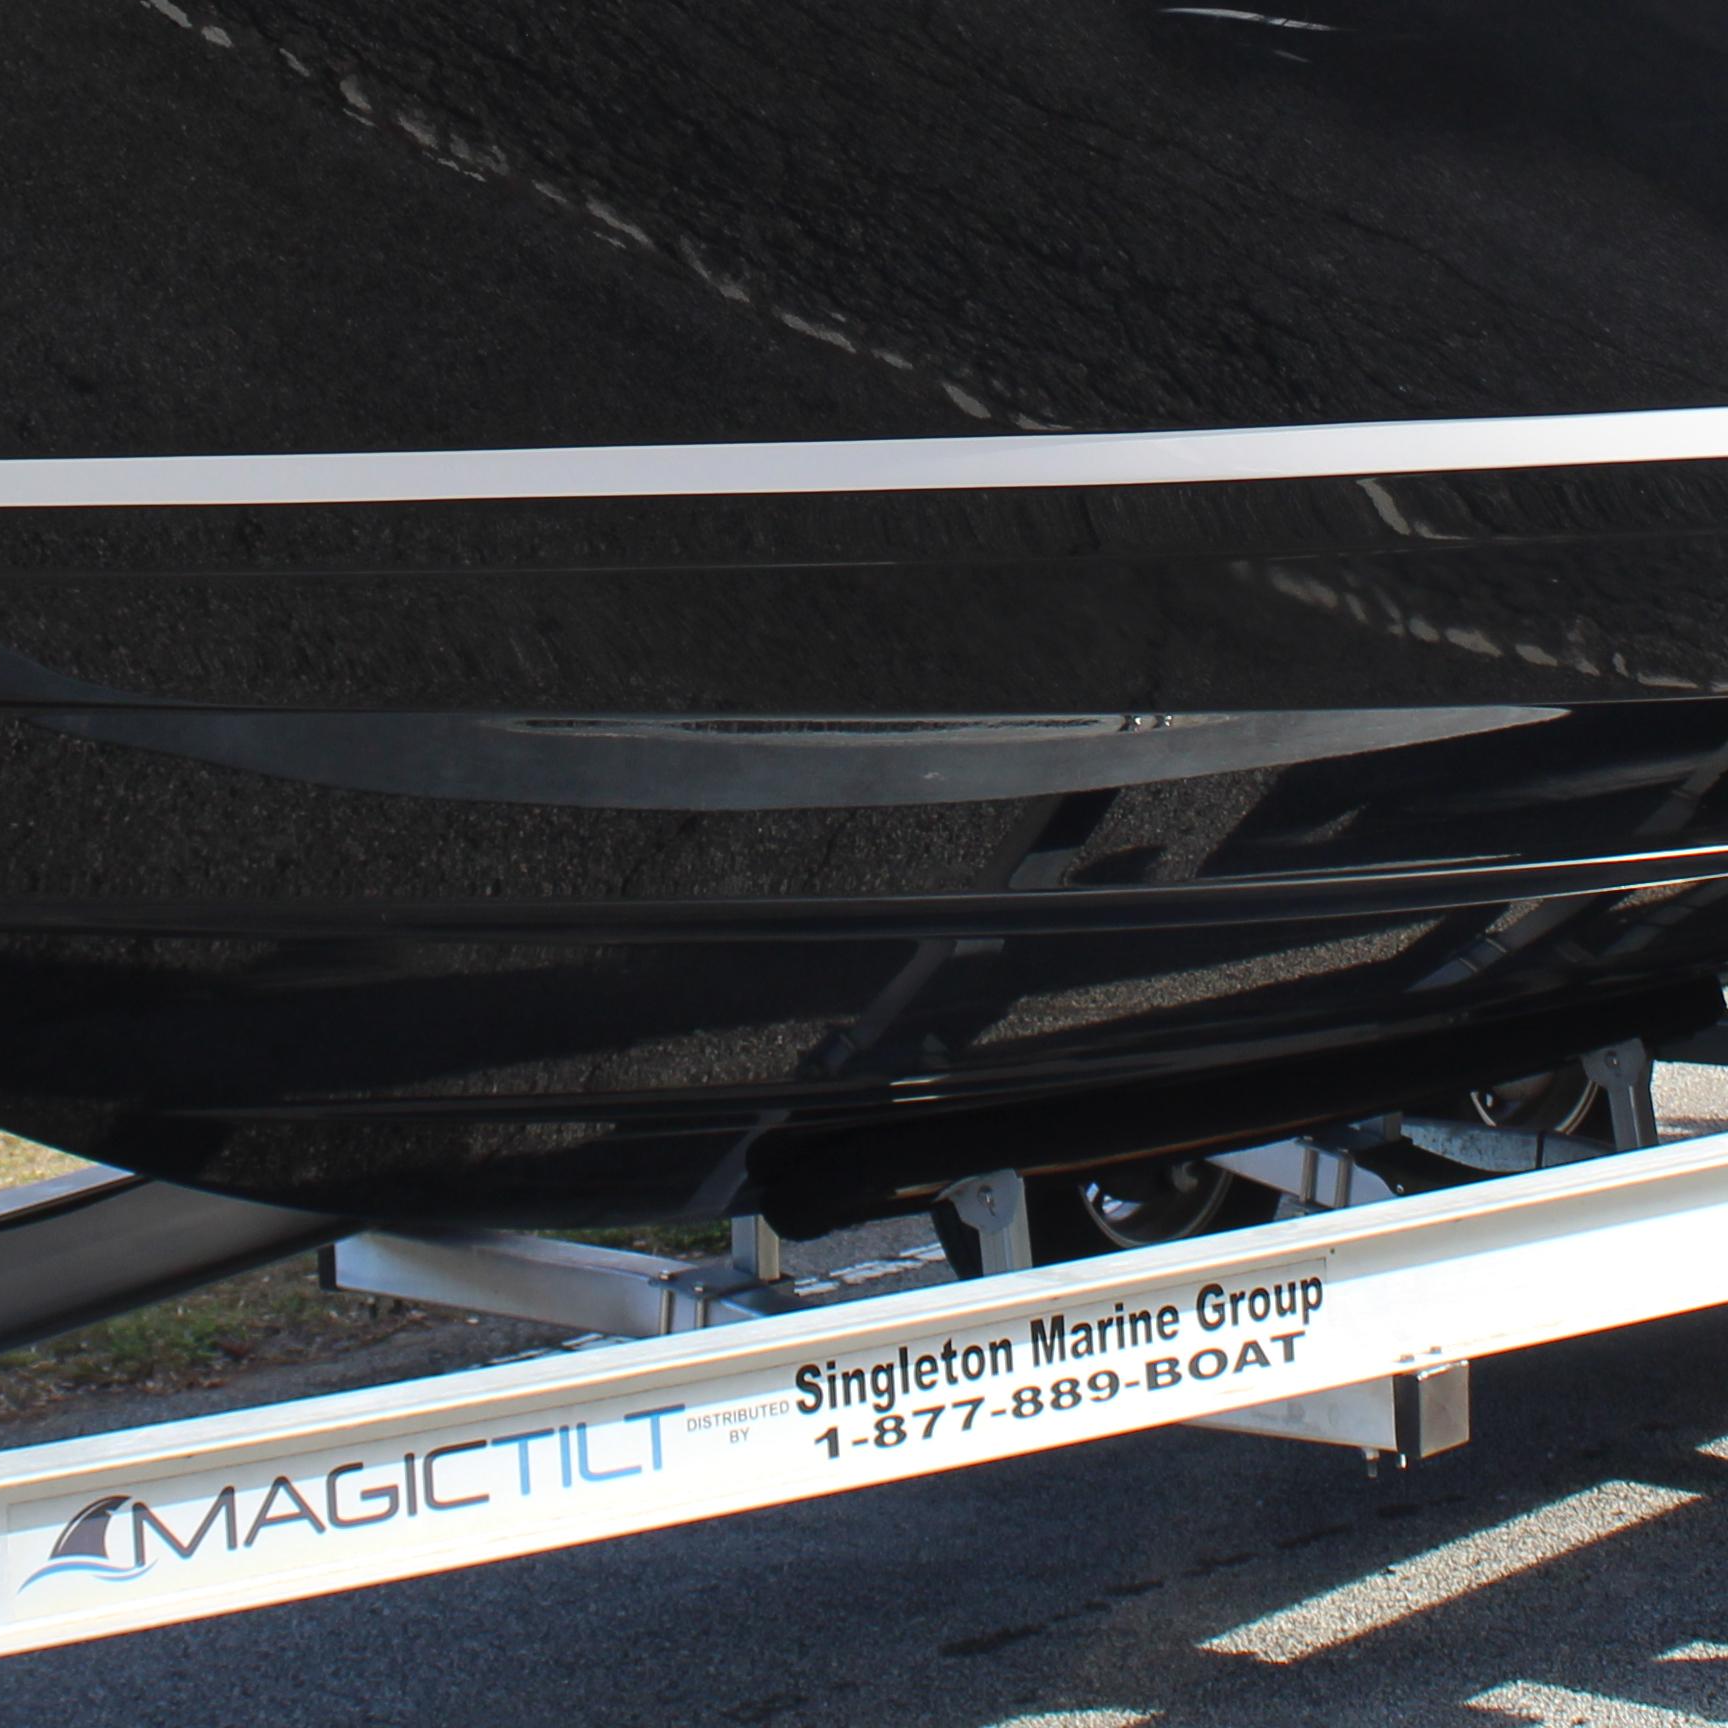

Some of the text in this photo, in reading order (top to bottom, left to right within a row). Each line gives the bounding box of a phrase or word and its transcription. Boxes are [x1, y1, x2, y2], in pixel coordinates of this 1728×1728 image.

[795, 1275, 1324, 1415] Singleton Marine Group
[686, 1399, 791, 1432] DISTRIBUTED
[814, 1330, 1307, 1459] 1-877-889-BOAT
[728, 1427, 751, 1444] BY
